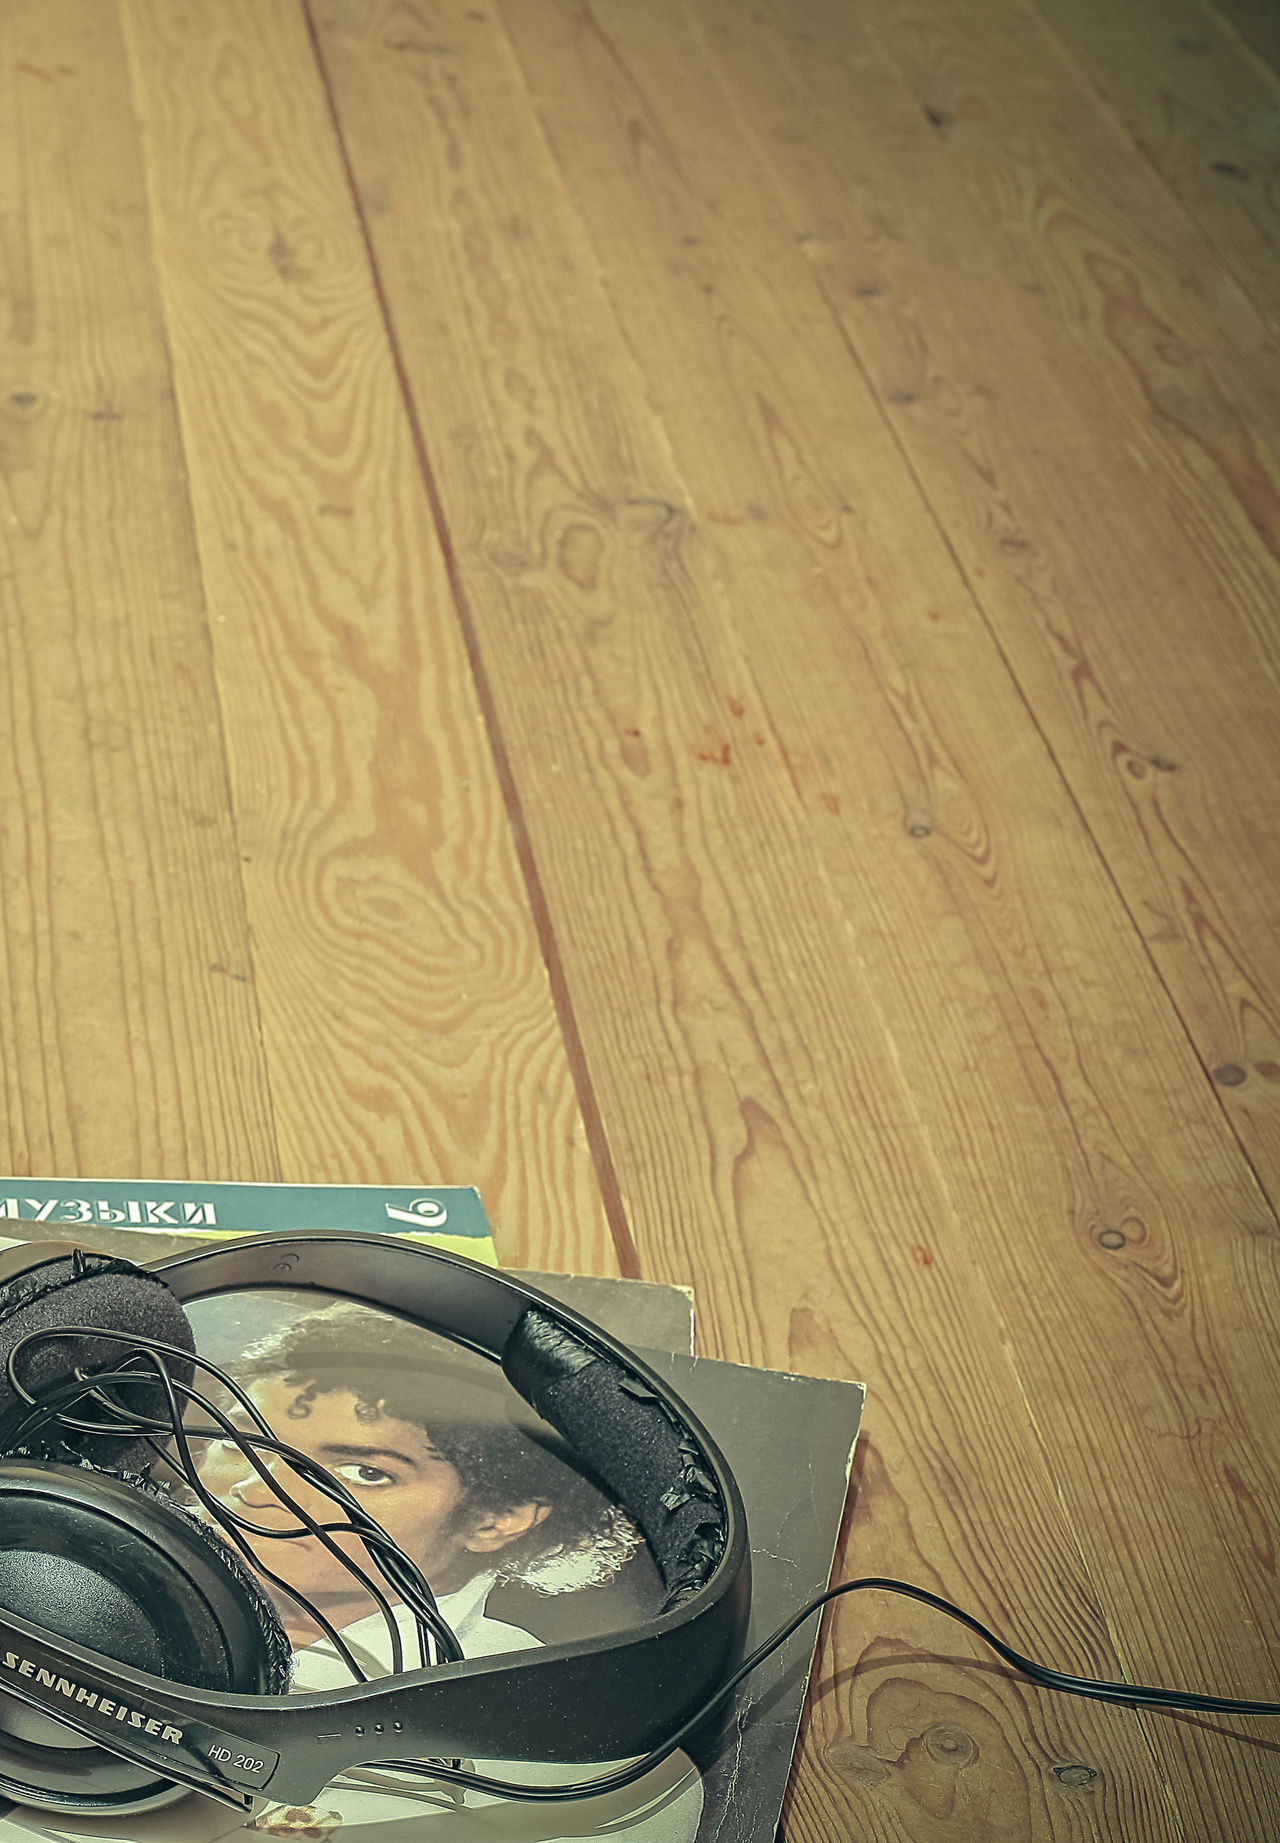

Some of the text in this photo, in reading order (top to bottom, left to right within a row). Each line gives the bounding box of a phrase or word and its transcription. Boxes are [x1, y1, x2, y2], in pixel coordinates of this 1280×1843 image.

[2, 1651, 183, 1745] SENNHEISER
[208, 1744, 264, 1774] HD 202
